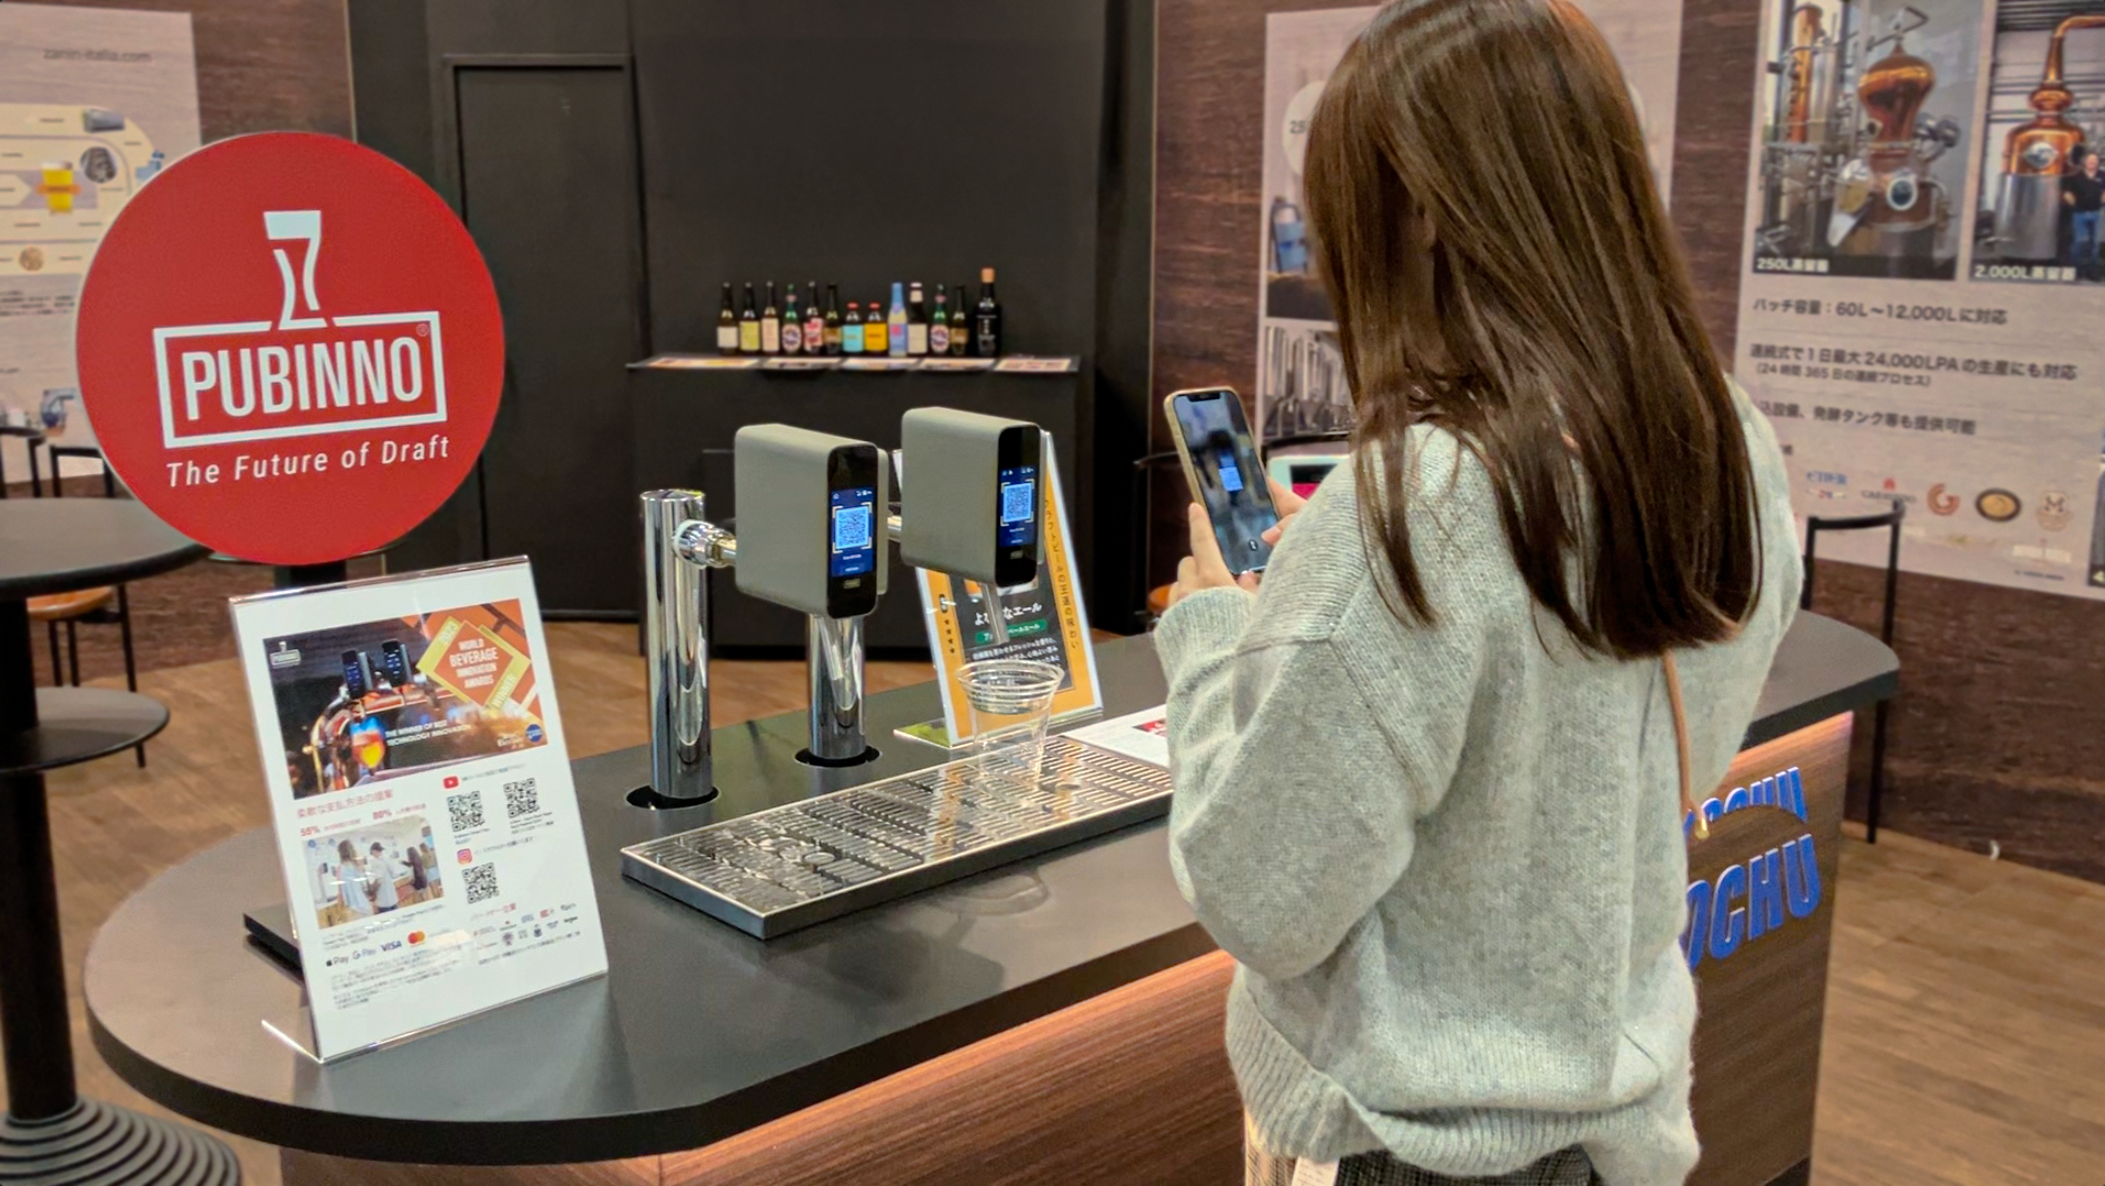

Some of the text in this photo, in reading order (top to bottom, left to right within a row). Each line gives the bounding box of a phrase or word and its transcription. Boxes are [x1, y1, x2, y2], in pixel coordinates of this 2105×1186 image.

[181, 336, 422, 422] PUBINNO
[166, 433, 450, 488] The Future of Draft
[449, 646, 500, 668] BEVERAGE
[380, 939, 403, 952] VISA
